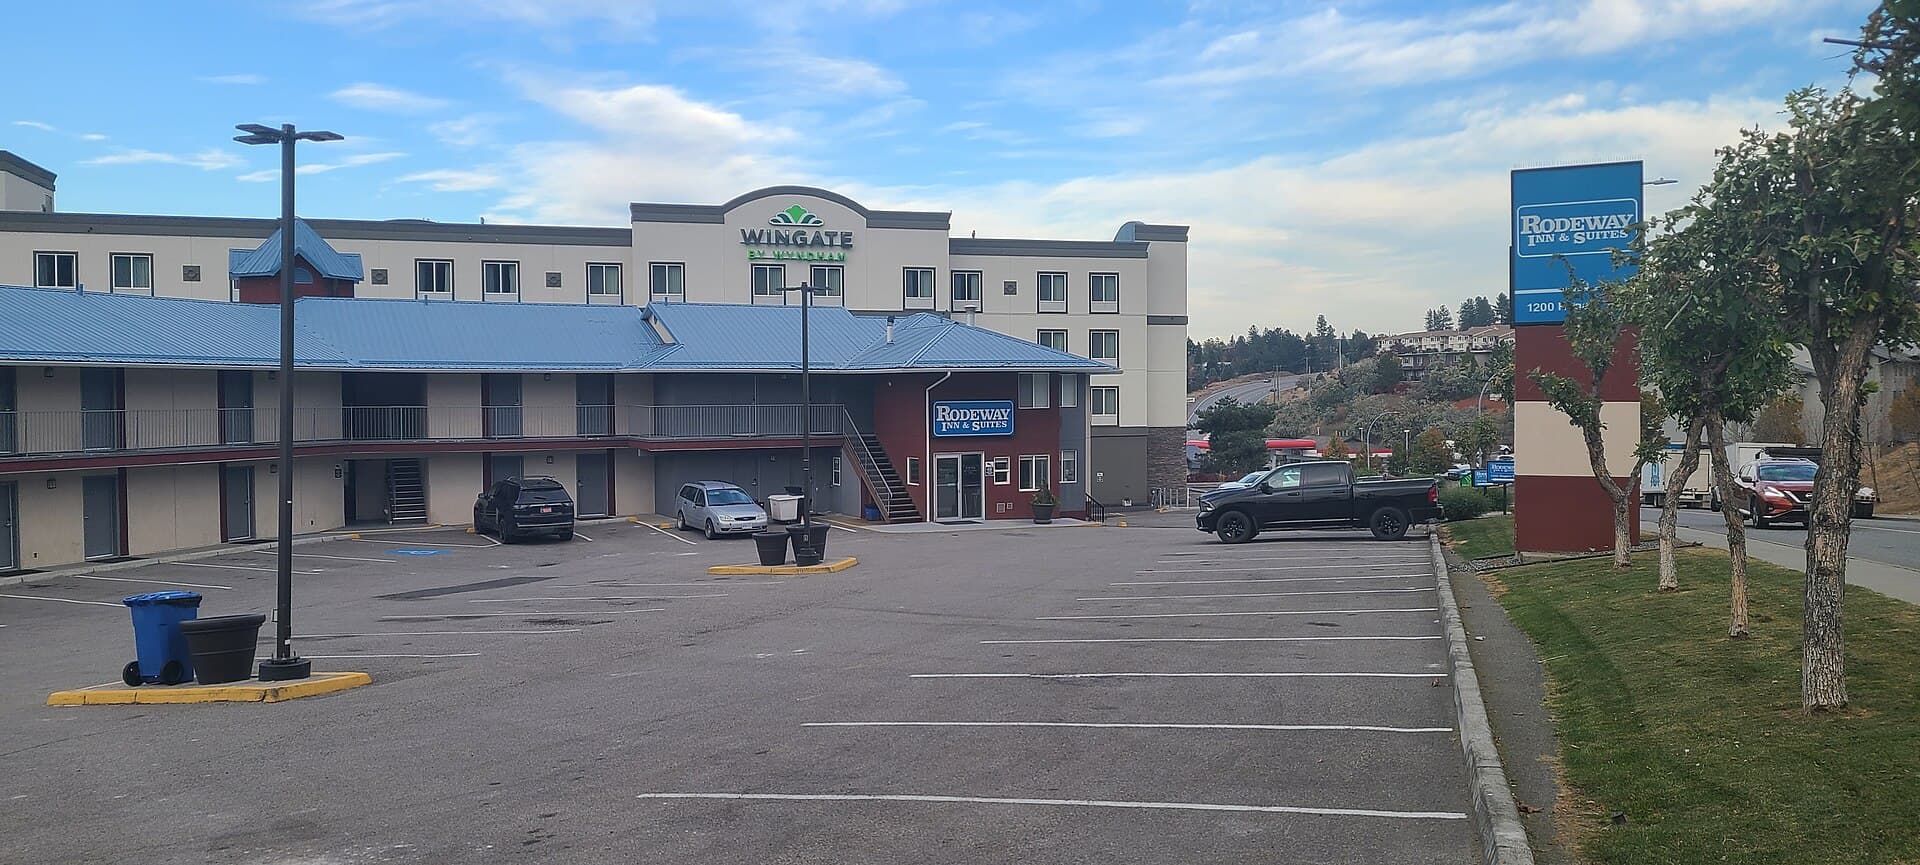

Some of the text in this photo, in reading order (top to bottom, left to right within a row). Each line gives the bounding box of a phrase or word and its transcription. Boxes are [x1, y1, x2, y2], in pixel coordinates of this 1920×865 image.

[1520, 214, 1634, 235] RODEWAY
[740, 228, 853, 248] WINGATE
[1527, 229, 1629, 247] INN & SUITES
[748, 249, 847, 262] BY WYNDHAM
[1527, 302, 1555, 313] 1200
[936, 405, 1011, 422] RODEWAY
[941, 420, 1007, 432] INN & SUITES
